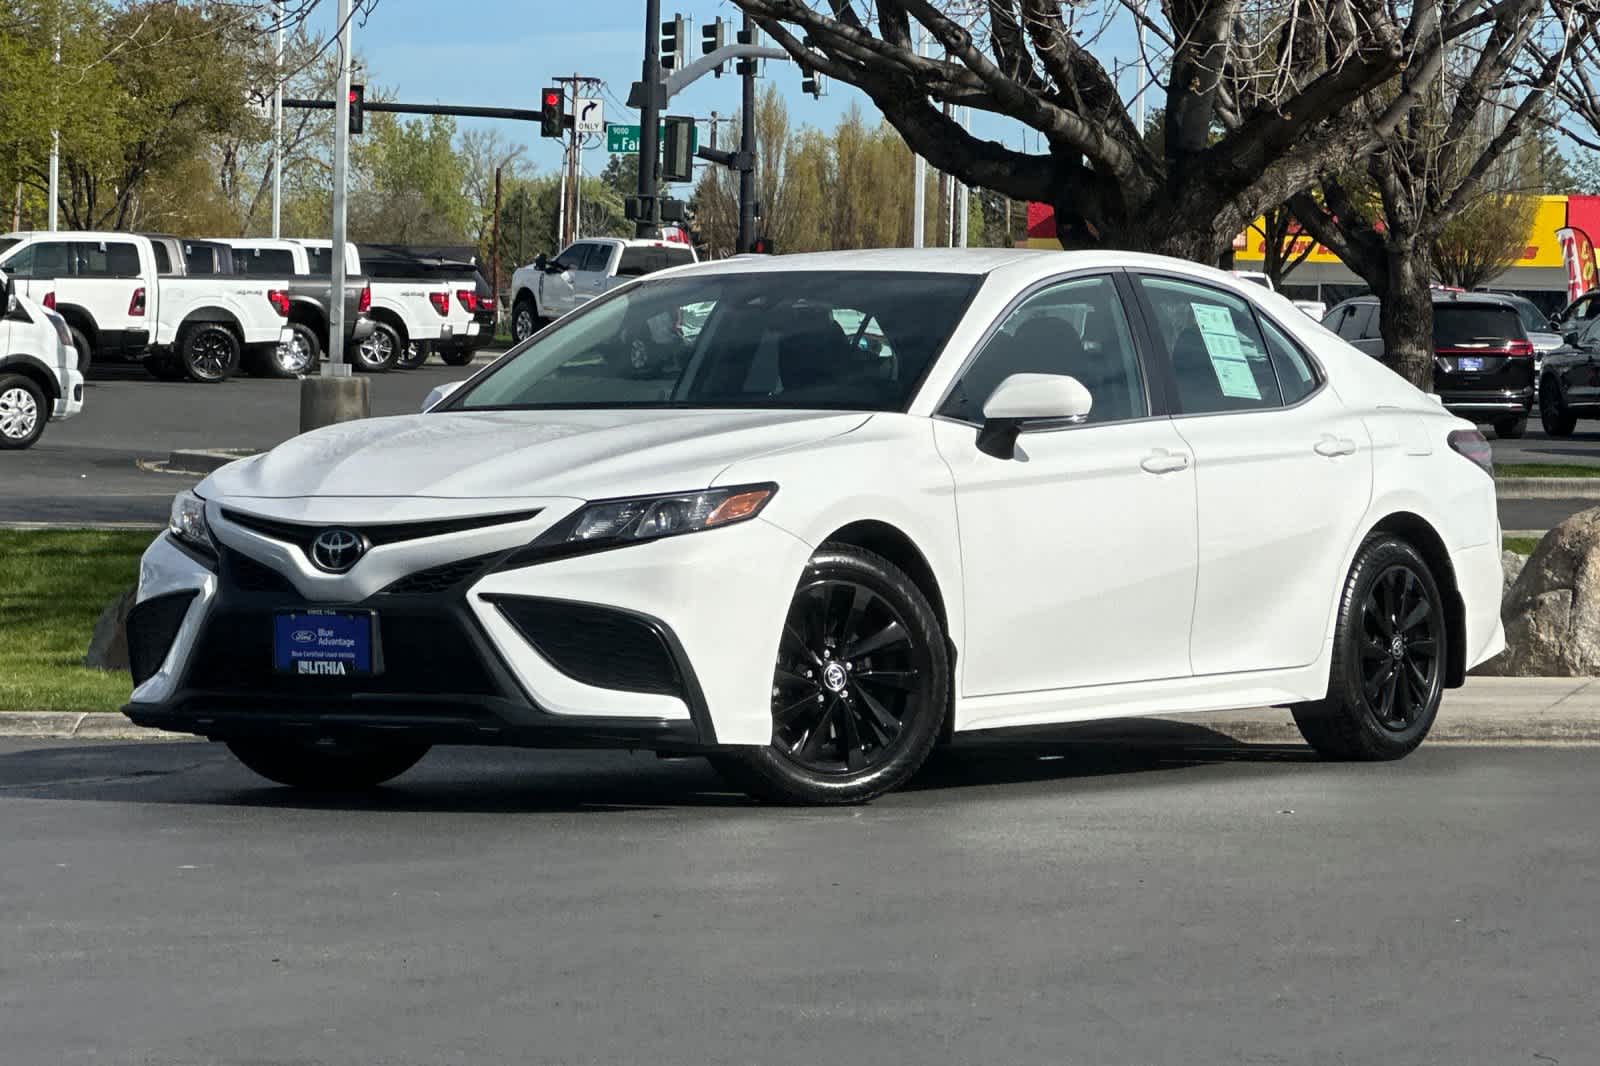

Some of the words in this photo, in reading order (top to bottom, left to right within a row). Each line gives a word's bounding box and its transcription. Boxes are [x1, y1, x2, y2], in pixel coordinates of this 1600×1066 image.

[612, 127, 630, 135] 9000
[317, 628, 334, 637] Blue
[318, 637, 355, 648] Advantage
[309, 660, 346, 675] LITHIA
